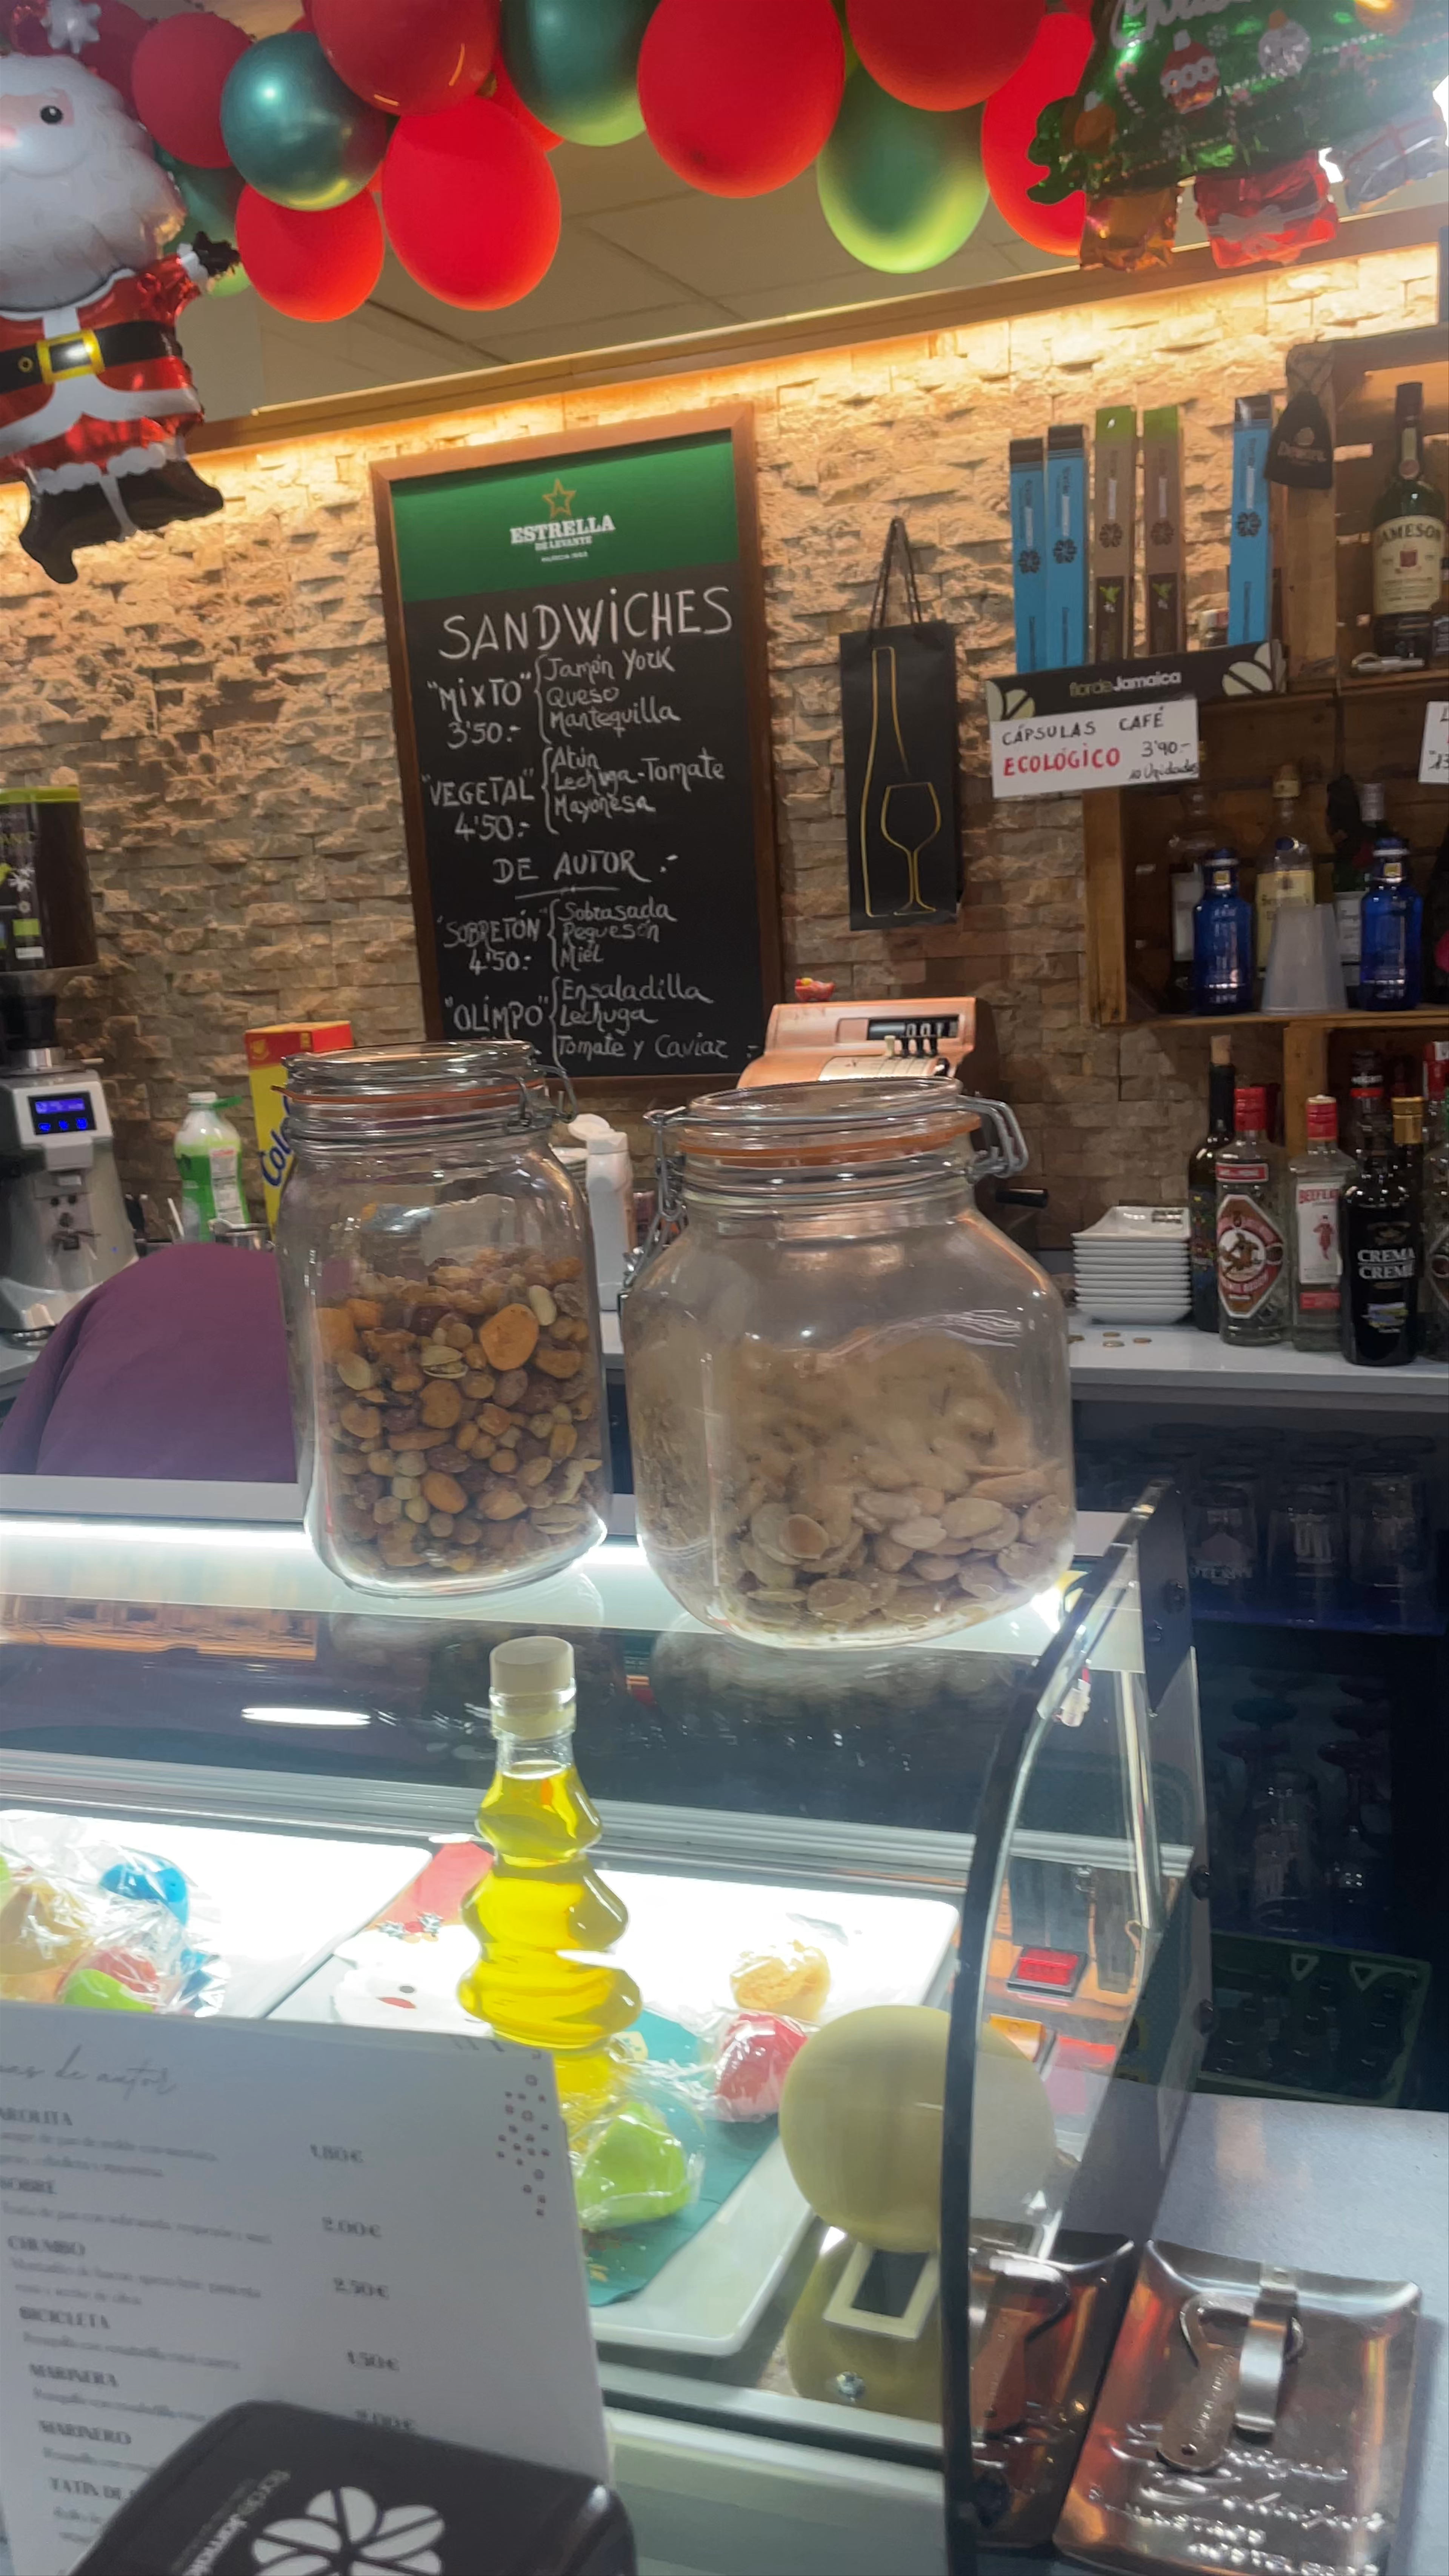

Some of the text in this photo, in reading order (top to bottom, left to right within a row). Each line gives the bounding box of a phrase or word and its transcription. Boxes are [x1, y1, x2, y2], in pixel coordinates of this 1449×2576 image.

[510, 515, 616, 544] ESTRELLA
[1377, 522, 1441, 543] AMESON
[546, 687, 620, 707] Queso
[550, 695, 681, 738] Mantequilla
[1119, 706, 1164, 731] CAFÉ
[555, 796, 656, 823] Mayonesa
[493, 858, 539, 884] DE
[554, 849, 652, 882] AUTOR
[563, 897, 677, 923] Sobrasada
[562, 972, 714, 1009] Ensaladilla
[559, 1029, 626, 1061] Tomate
